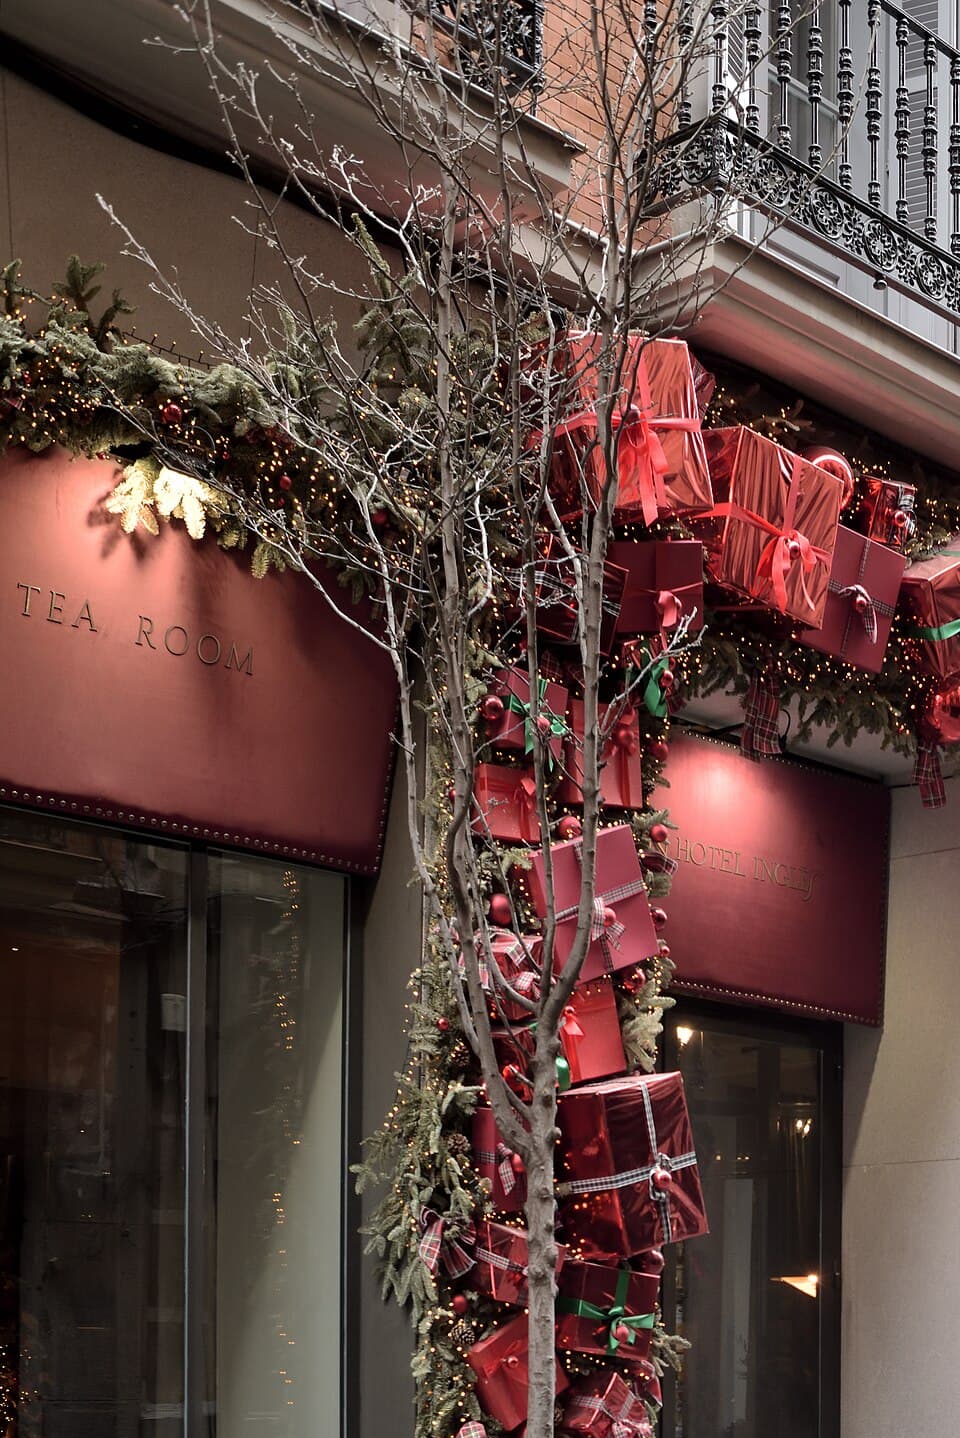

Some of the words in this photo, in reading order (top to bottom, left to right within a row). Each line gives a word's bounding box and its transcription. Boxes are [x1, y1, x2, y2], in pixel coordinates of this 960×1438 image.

[16, 582, 98, 632] TEA
[135, 615, 254, 676] ROOM
[676, 837, 746, 877] HOTEL
